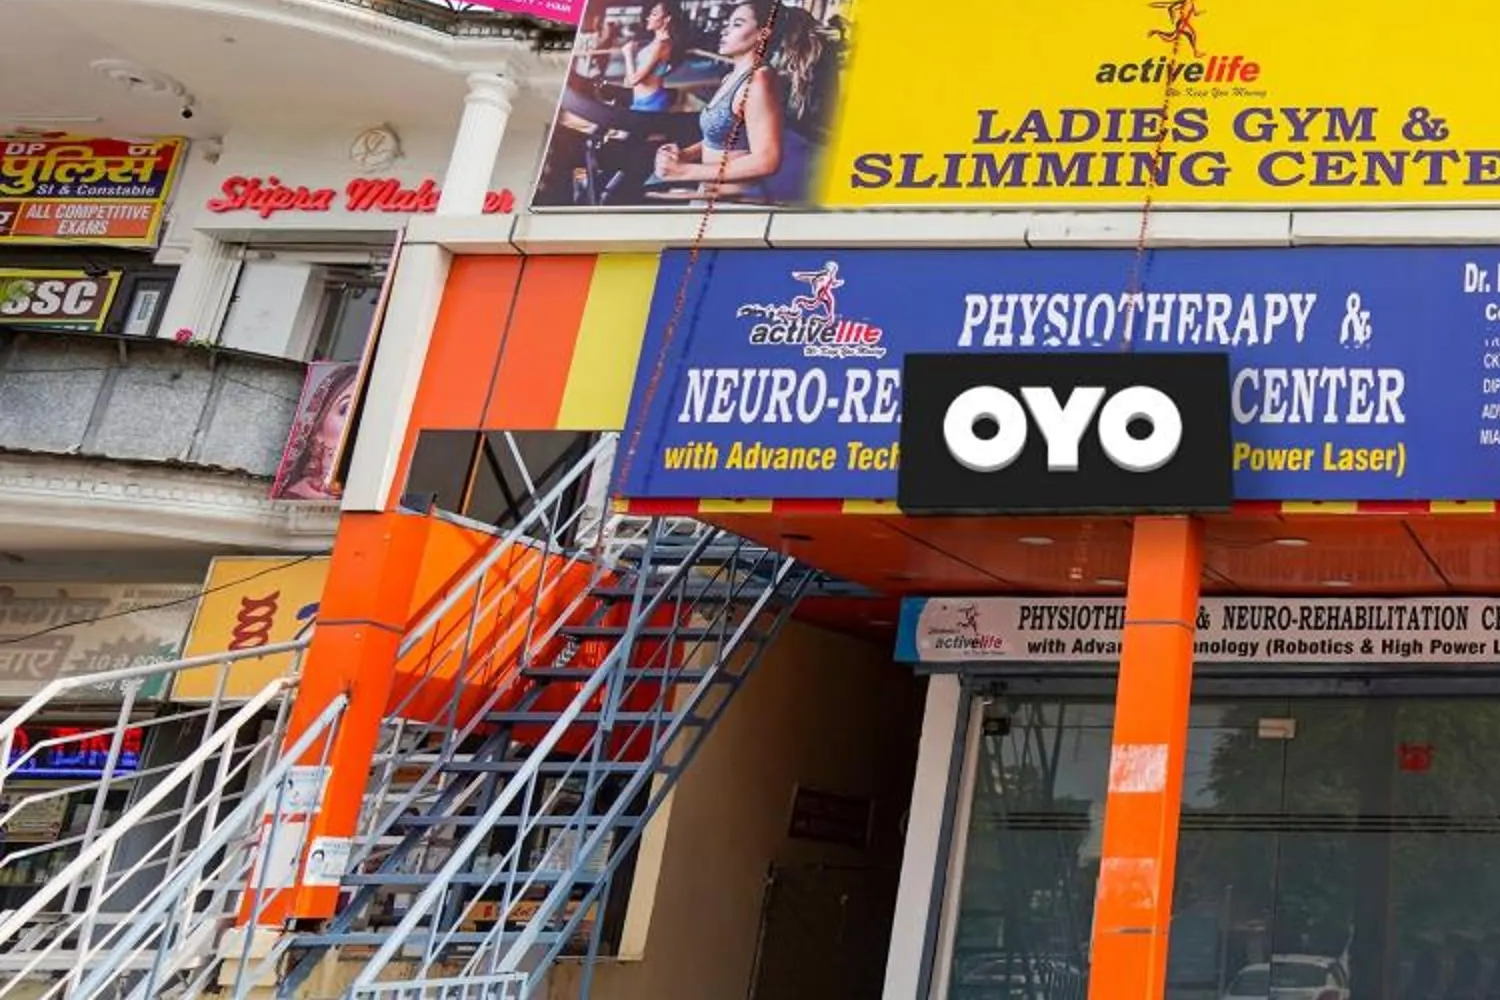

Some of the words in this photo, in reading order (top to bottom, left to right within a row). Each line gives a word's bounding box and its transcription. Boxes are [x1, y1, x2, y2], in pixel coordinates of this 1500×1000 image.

[1096, 56, 1261, 83] activelife
[973, 107, 1210, 144] LADIES
[1232, 107, 1379, 143] GYM
[1401, 107, 1451, 142] &
[0, 145, 163, 195] पुलिस
[850, 150, 1232, 190] SLIMMING
[58, 183, 72, 195] &
[77, 184, 157, 197] Constable
[207, 175, 337, 219] Shipra
[26, 203, 51, 220] ALL
[55, 204, 152, 221] COMPETITIVE
[57, 219, 110, 235] EXAMS
[1463, 263, 1491, 293] Dr.
[1, 280, 98, 315] SSC
[957, 291, 1317, 348] PHYSIOTHERAPY
[1339, 292, 1372, 348] &
[677, 367, 903, 425] NEURO-RE
[1231, 366, 1406, 425] CENTER
[943, 385, 1183, 472] OYO
[664, 442, 719, 470] with
[724, 441, 836, 470] Advance
[1232, 443, 1314, 471] Power
[1324, 442, 1407, 477] Laser)
[1221, 605, 1469, 631] NEURO-REHABILITATION
[935, 635, 1004, 650] activelife
[1027, 638, 1067, 654] with
[1071, 638, 1123, 654] Adva
[1193, 638, 1260, 657] nology
[1266, 638, 1356, 657] (Robotics
[1360, 639, 1375, 655] &
[1380, 638, 1424, 657] High
[1429, 639, 1489, 655] Power
